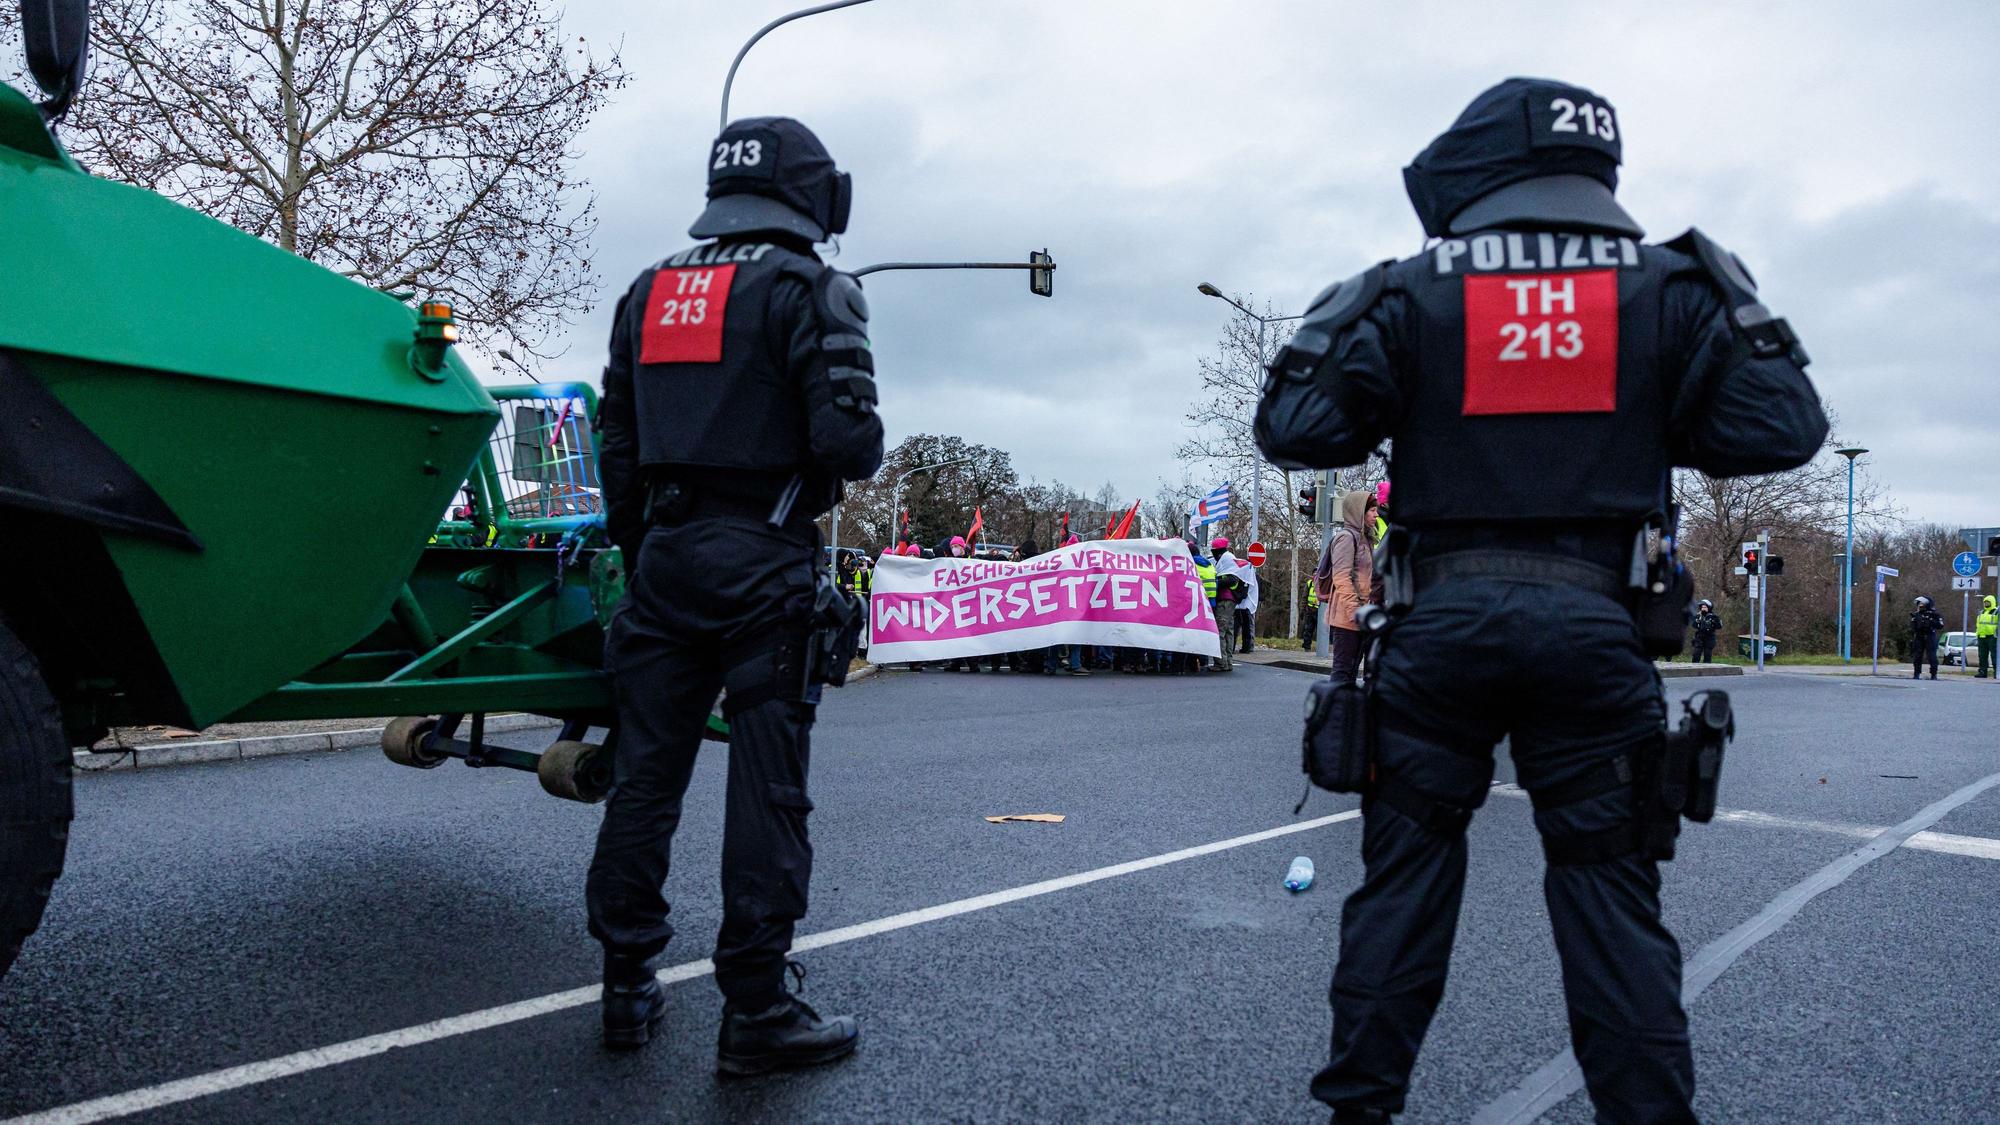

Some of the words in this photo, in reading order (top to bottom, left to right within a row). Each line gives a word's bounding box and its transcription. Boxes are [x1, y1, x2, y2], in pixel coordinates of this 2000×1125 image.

[1550, 98, 1616, 142] 213
[713, 139, 762, 170] 213
[1436, 232, 1639, 274] POLIZEI
[676, 270, 713, 295] TH
[1506, 278, 1576, 316] TH
[660, 297, 707, 326] 213
[1499, 320, 1585, 361] 213
[877, 573, 1169, 634] WIDERSETZEN
